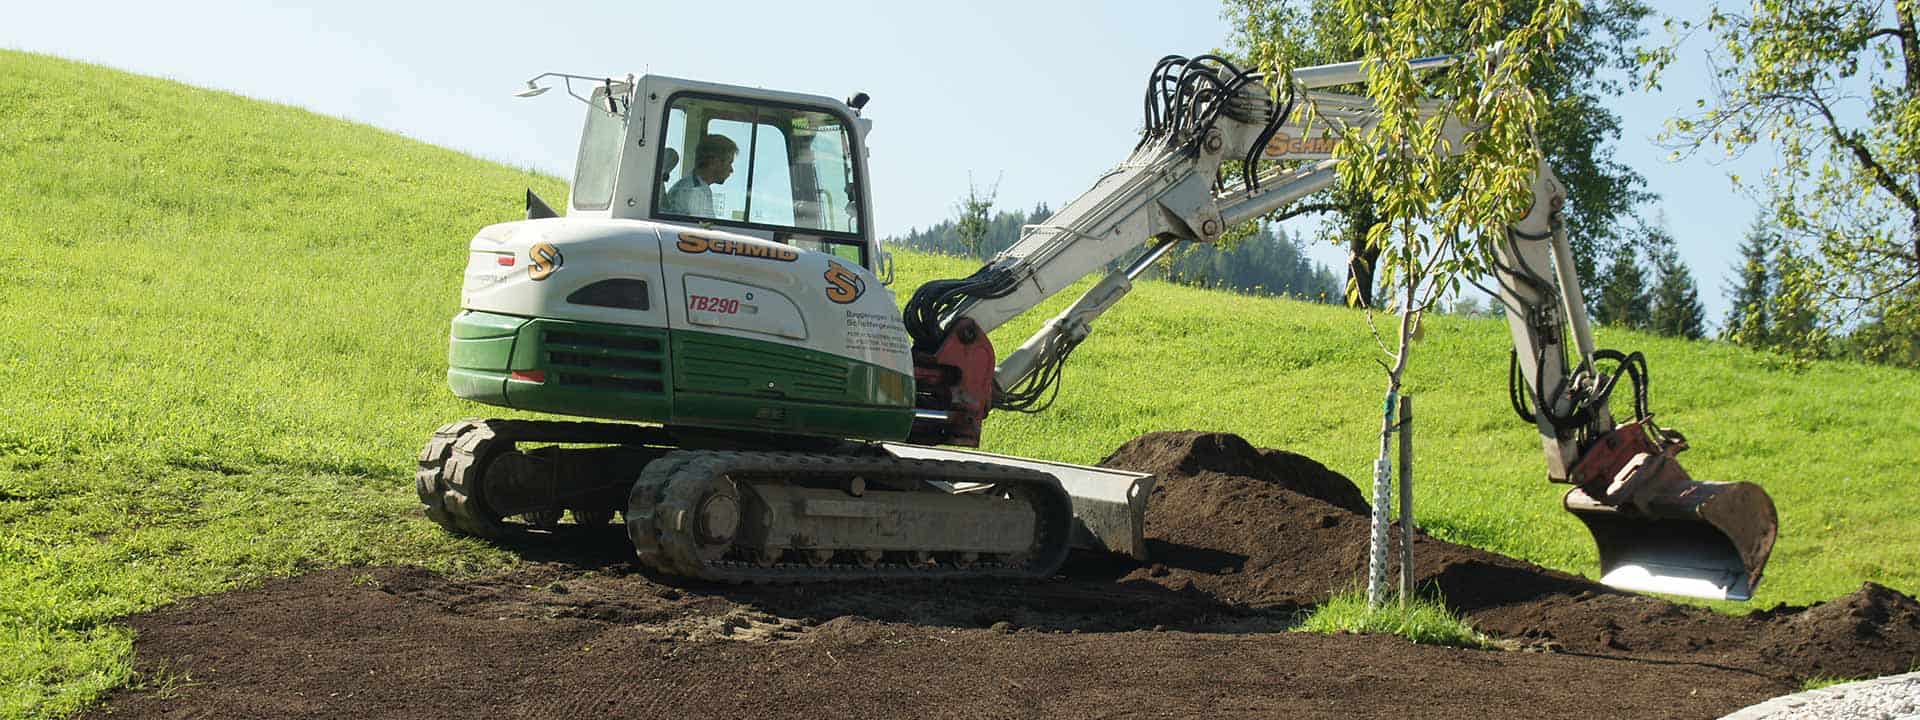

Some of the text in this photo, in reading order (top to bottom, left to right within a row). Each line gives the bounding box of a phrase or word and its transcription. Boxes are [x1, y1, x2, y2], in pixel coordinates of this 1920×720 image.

[1264, 132, 1341, 157] SCHM
[677, 231, 799, 262] SCHMID
[689, 295, 739, 314] TB290
